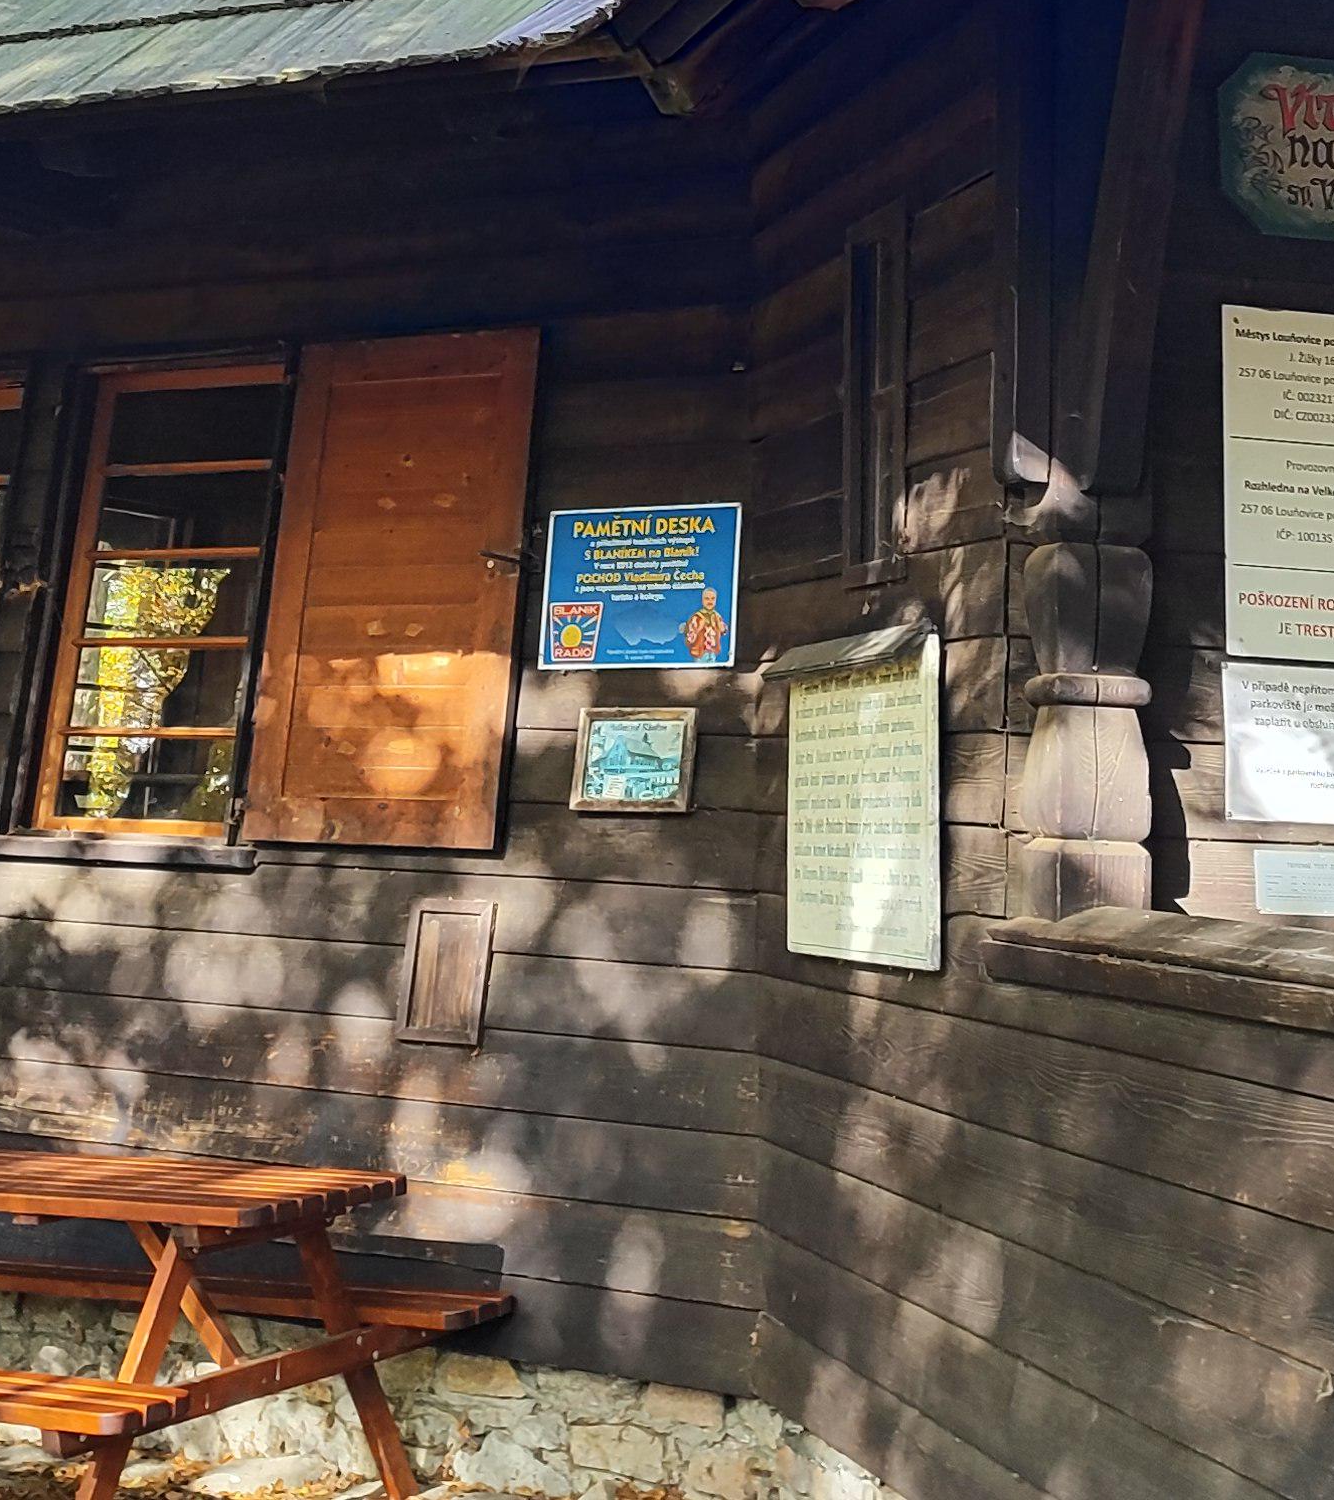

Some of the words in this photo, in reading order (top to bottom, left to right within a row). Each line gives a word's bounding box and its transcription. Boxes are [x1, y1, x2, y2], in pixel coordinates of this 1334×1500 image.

[1235, 327, 1270, 342] Městys
[1272, 331, 1322, 347] Louňovice
[1289, 353, 1296, 363] J.
[1298, 351, 1322, 367] Žižky
[1238, 367, 1256, 378] 257
[1259, 369, 1271, 379] 06
[1273, 370, 1322, 384] Louňovice
[1274, 408, 1294, 420] DIČ:
[1244, 480, 1295, 494] Rozhledna
[1297, 486, 1310, 495] na
[1240, 503, 1259, 514] 257
[1261, 505, 1274, 515] 06
[1275, 506, 1325, 520] Louňovice
[573, 514, 653, 538] PAMĚTNÍ
[655, 515, 716, 535] DESKA
[576, 572, 622, 584] POCHOD
[1238, 590, 1314, 610] POŠKOZENÍ
[1278, 622, 1292, 635] JE
[554, 647, 592, 658] RADIO
[1242, 680, 1249, 689] V
[1252, 680, 1290, 693] případě
[1250, 698, 1301, 711] parkoviště
[1303, 700, 1312, 713] je
[1255, 716, 1292, 728] zaplatit
